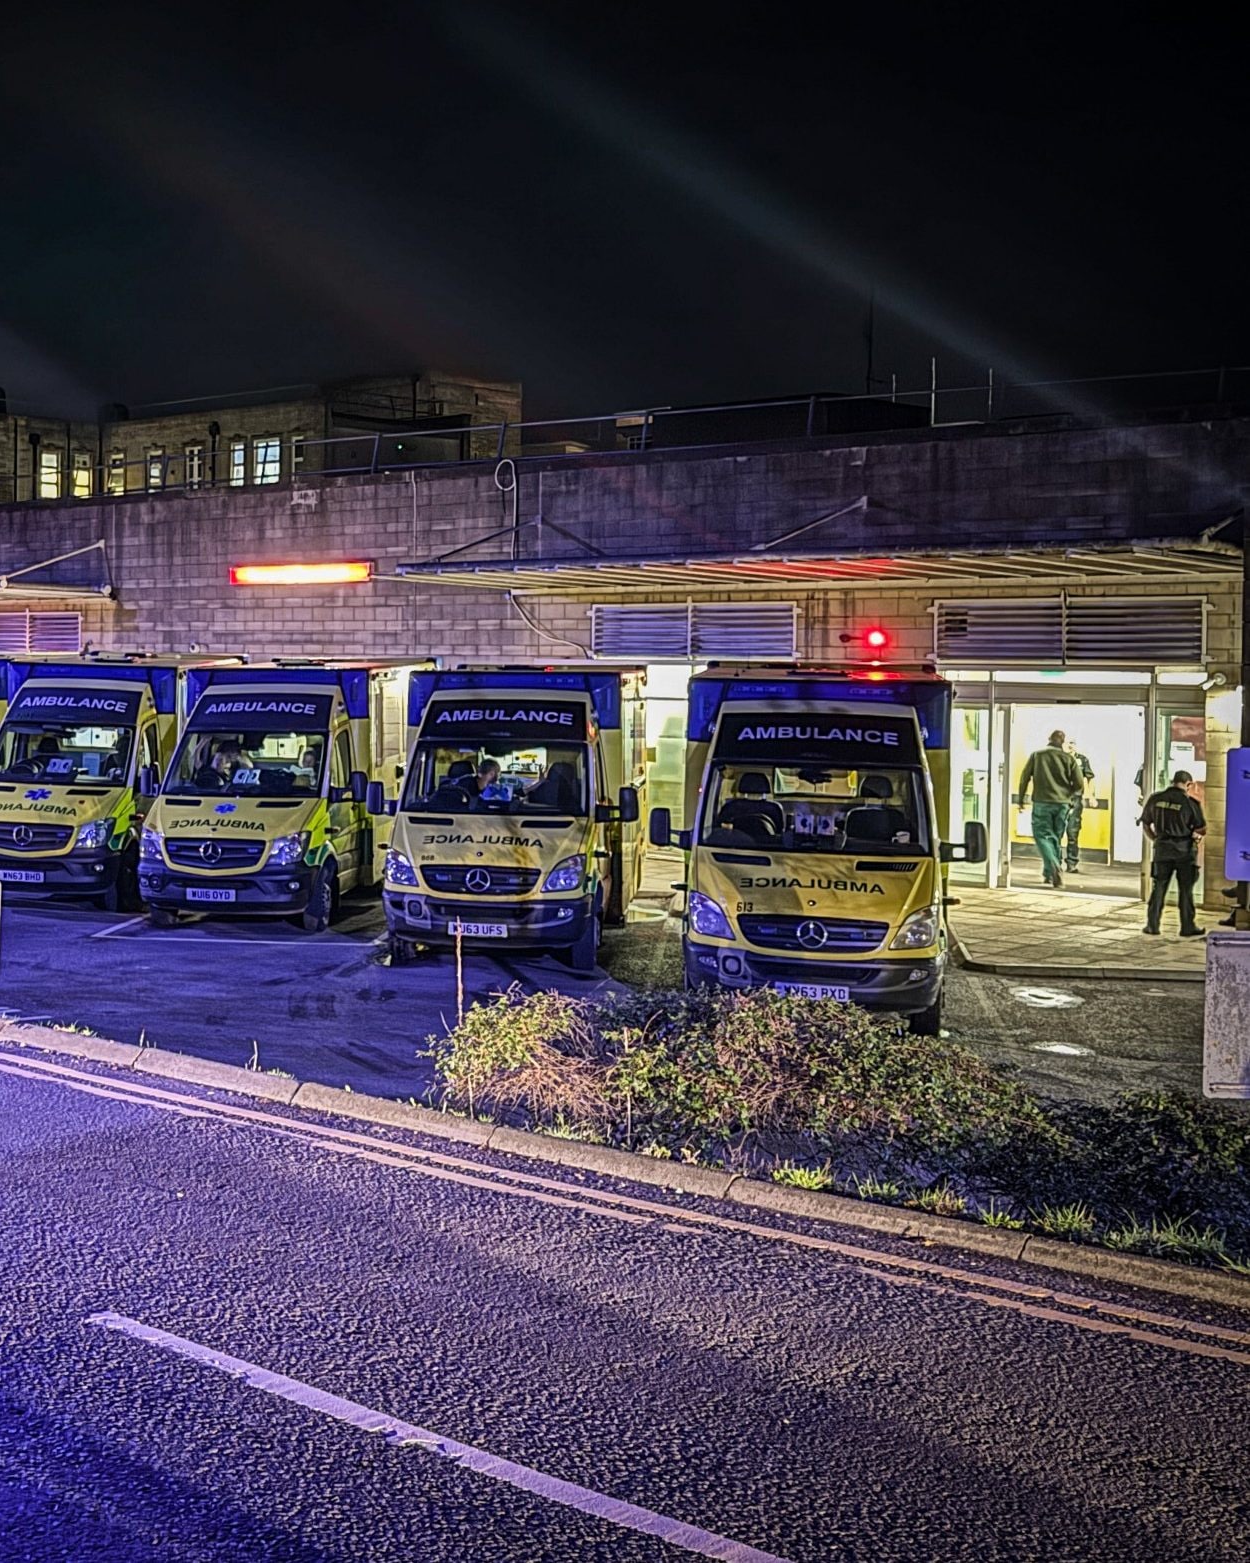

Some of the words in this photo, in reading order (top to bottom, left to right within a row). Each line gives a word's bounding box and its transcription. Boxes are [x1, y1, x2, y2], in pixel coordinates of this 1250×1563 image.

[19, 696, 128, 713] AMBULANCE
[205, 701, 317, 715] AMBULANCE
[436, 709, 573, 725] AMBULANCE
[737, 726, 899, 746] AMBULANCE
[736, 901, 754, 913] 613
[482, 925, 503, 936] UFS
